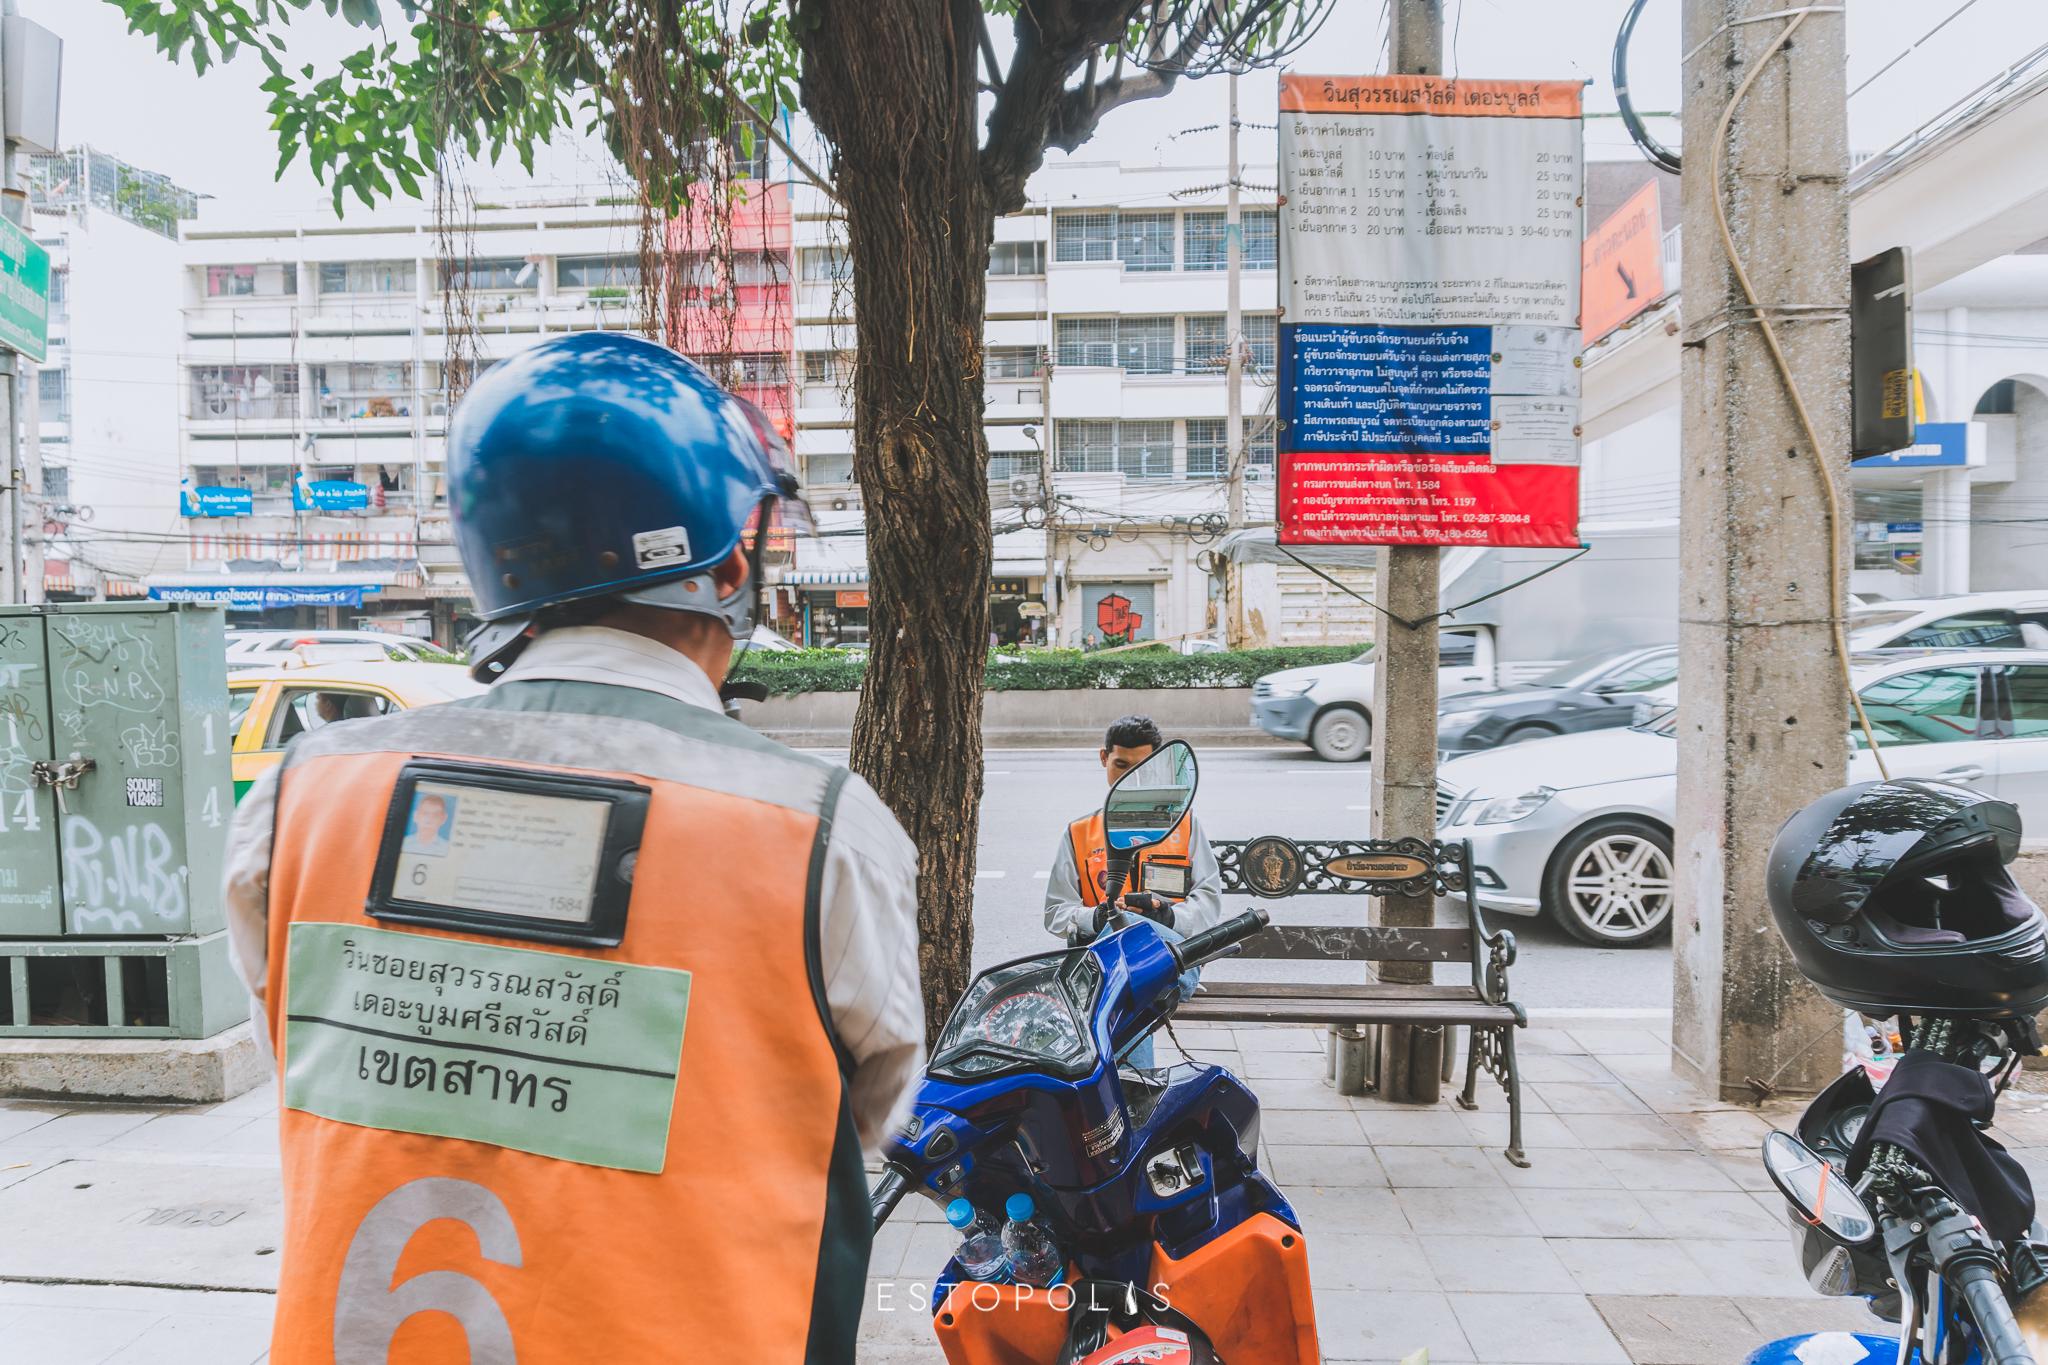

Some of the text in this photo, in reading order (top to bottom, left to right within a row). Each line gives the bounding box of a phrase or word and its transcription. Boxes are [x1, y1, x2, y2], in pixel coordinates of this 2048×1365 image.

[1323, 80, 1540, 113] วินสุวรรณสวัสดิ์ เดอะบูลส์
[1368, 151, 1381, 160] 10
[1385, 151, 1406, 161] บาท
[1536, 153, 1550, 163] 20
[1553, 153, 1574, 164] บาท
[1368, 169, 1381, 179] 15
[1384, 169, 1406, 180] บาท
[1536, 171, 1550, 182] 25
[1553, 172, 1574, 182] บาท
[1367, 188, 1381, 198] 15
[1384, 188, 1406, 199] บาท
[1536, 190, 1550, 200] 20
[1553, 190, 1574, 201] บาท
[1350, 206, 1358, 216] 2
[1367, 206, 1381, 217] 20
[1384, 207, 1406, 217] บาท
[1537, 208, 1550, 218] 25
[1553, 208, 1574, 219] บาท
[1351, 224, 1358, 234] 3
[1367, 225, 1381, 236] 20
[1384, 225, 1406, 236] บาท
[1507, 226, 1514, 236] 3
[1520, 226, 1549, 237] 30-40
[1553, 227, 1574, 238] บาท
[1366, 294, 1377, 303] 25
[1379, 295, 1398, 304] บาท
[1512, 296, 1530, 305] บาท
[1293, 329, 1469, 348] ข้อแนะนำผู้ขับรถจักรยานยนต์รับจ้าง
[1421, 371, 1438, 381] สุรา
[1444, 435, 1451, 444] 3
[1393, 478, 1414, 490] โทร.
[1416, 480, 1441, 490] 1584
[1430, 494, 1450, 507] โทร.
[1453, 497, 1477, 507] 1197
[1440, 511, 1460, 524] โทร.
[202, 713, 217, 756] 1
[201, 785, 222, 829] 4
[411, 863, 429, 886] 6
[548, 896, 583, 912] 1584
[343, 939, 626, 1009] วินซอยสุวรรณสวัสดิ์
[353, 991, 594, 1046] เดอะบูมศรีสวัสดิ์
[358, 1045, 573, 1113] เขตสาทร
[333, 1177, 525, 1365] 6
